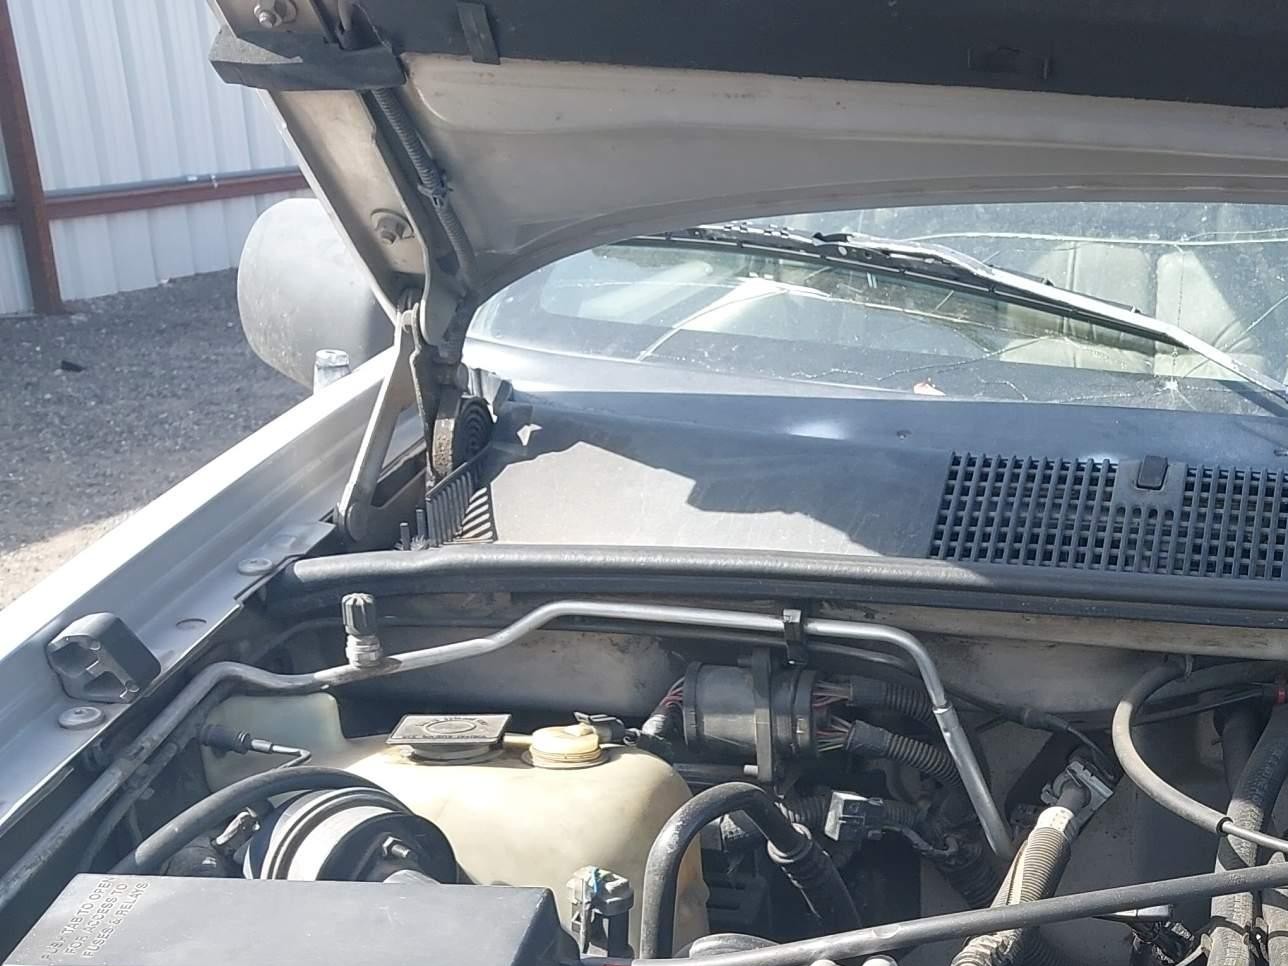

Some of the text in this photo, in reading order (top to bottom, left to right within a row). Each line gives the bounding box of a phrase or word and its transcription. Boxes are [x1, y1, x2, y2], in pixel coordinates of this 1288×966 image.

[77, 902, 94, 915] TO
[83, 896, 118, 933] ACCESS
[111, 883, 128, 896] TO
[83, 927, 114, 957] FUSES
[115, 882, 150, 916] RELAYS
